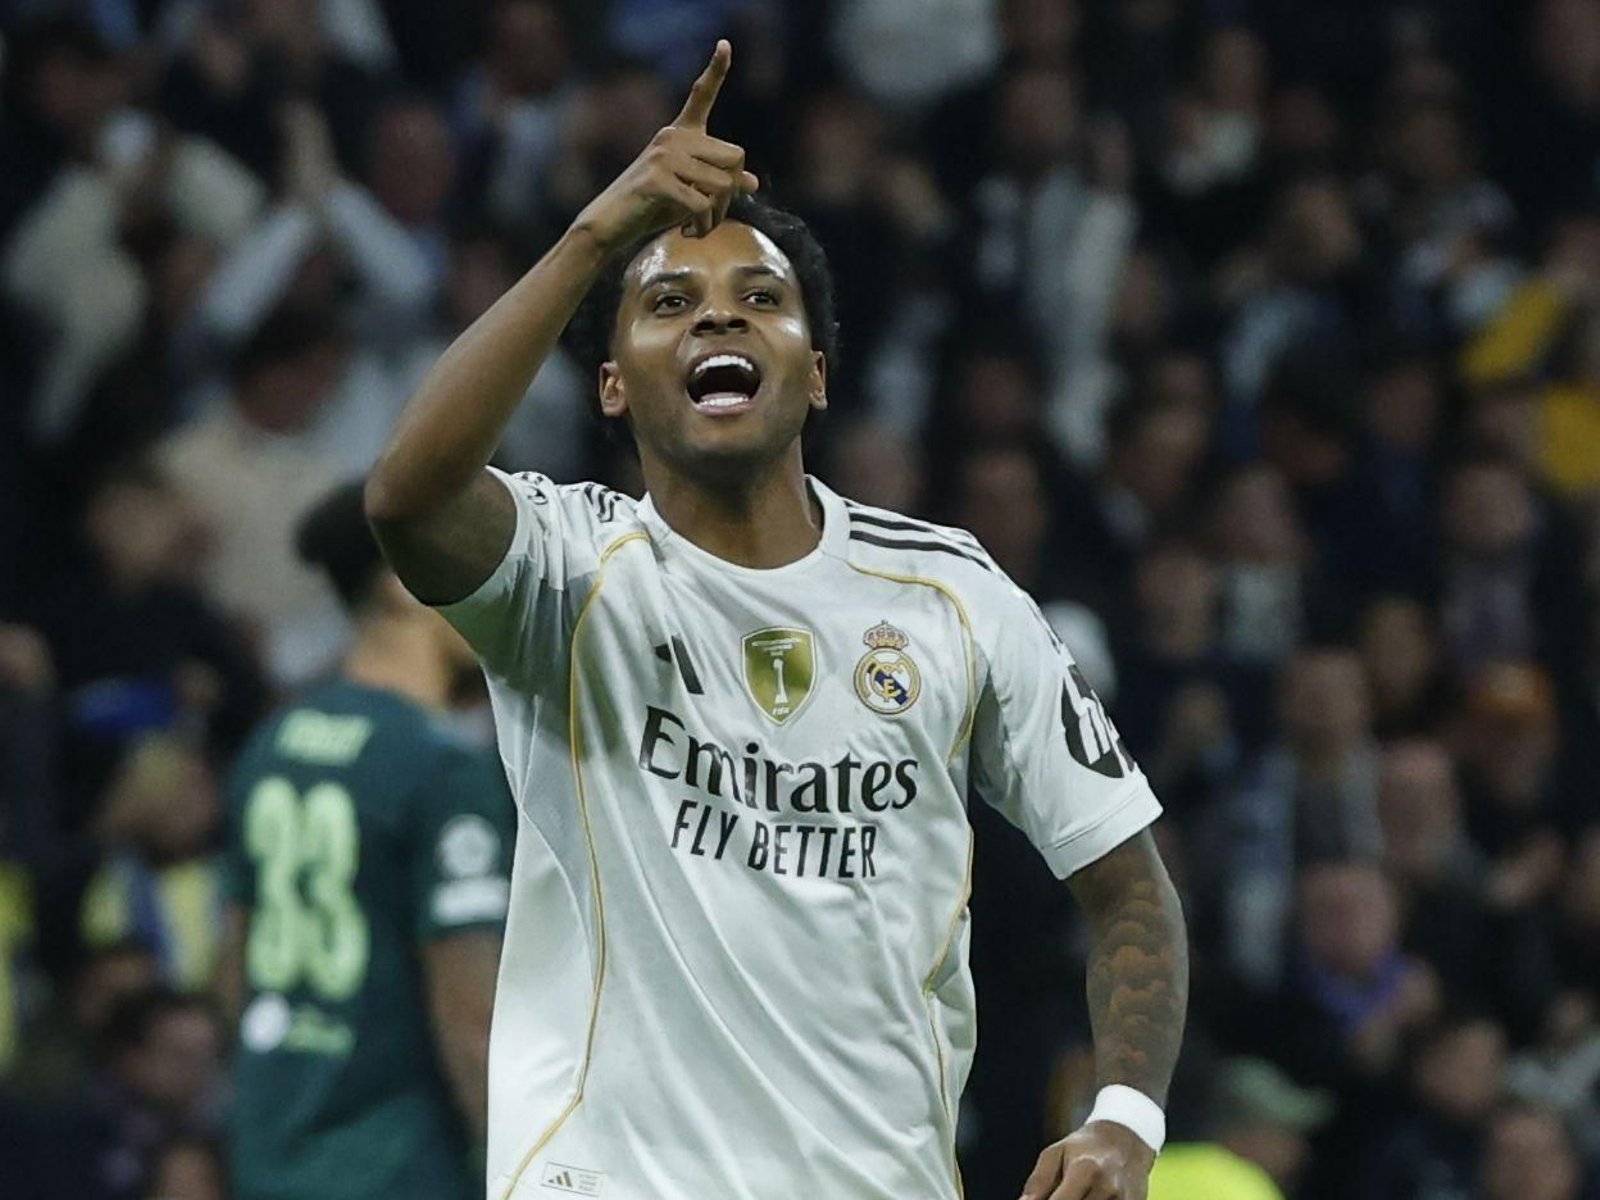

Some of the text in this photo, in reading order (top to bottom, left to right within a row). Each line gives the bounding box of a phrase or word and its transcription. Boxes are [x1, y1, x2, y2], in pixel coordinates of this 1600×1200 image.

[639, 704, 919, 814] Emirates
[670, 799, 878, 879] FLY BETTER
